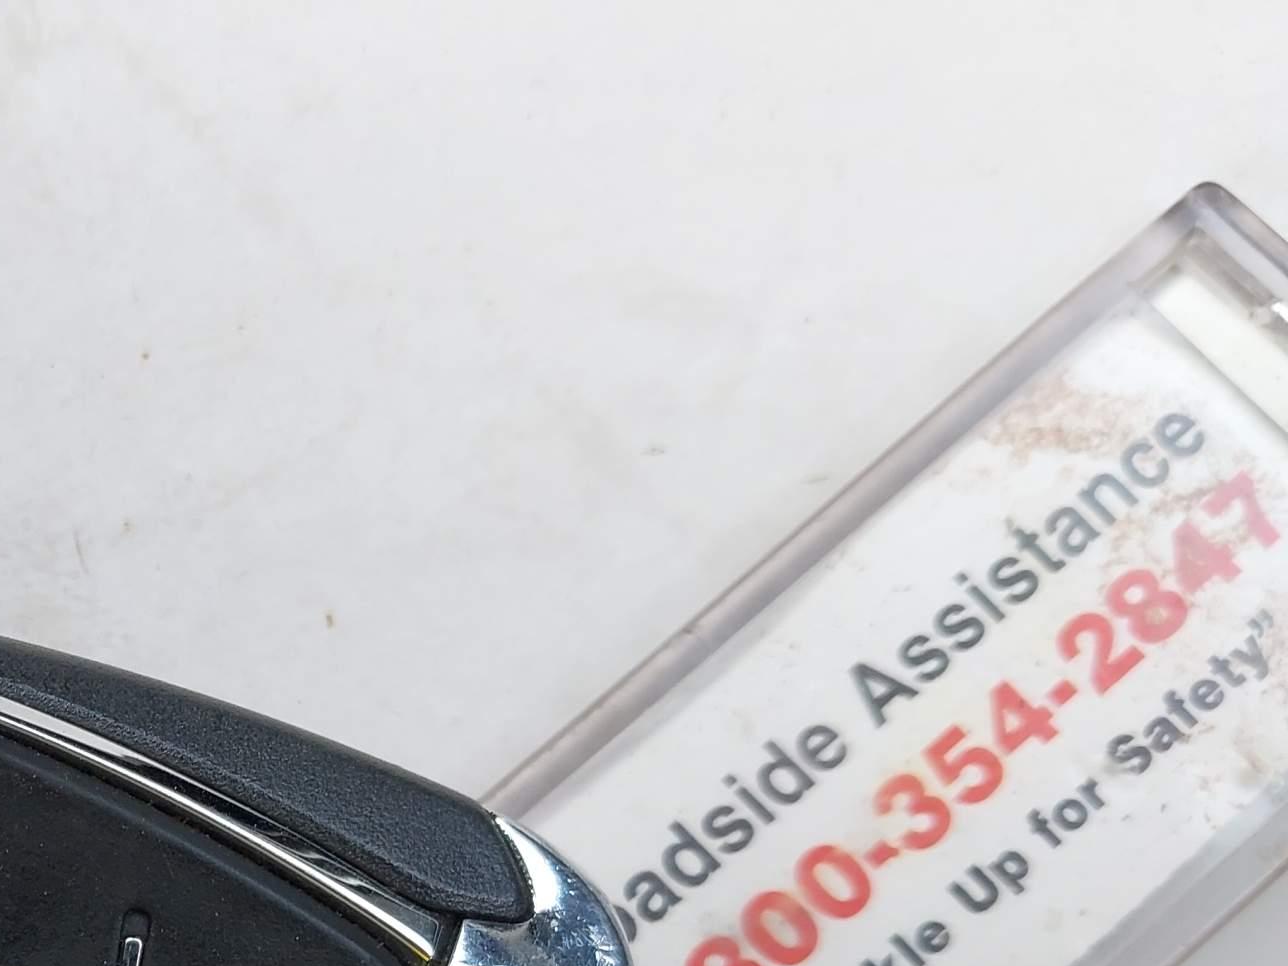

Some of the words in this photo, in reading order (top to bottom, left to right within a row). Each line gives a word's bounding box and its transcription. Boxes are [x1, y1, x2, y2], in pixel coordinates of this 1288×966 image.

[848, 411, 1205, 729] Assistance
[948, 848, 1031, 914] Up
[1027, 776, 1108, 849] for
[1107, 607, 1275, 776] Safety”
